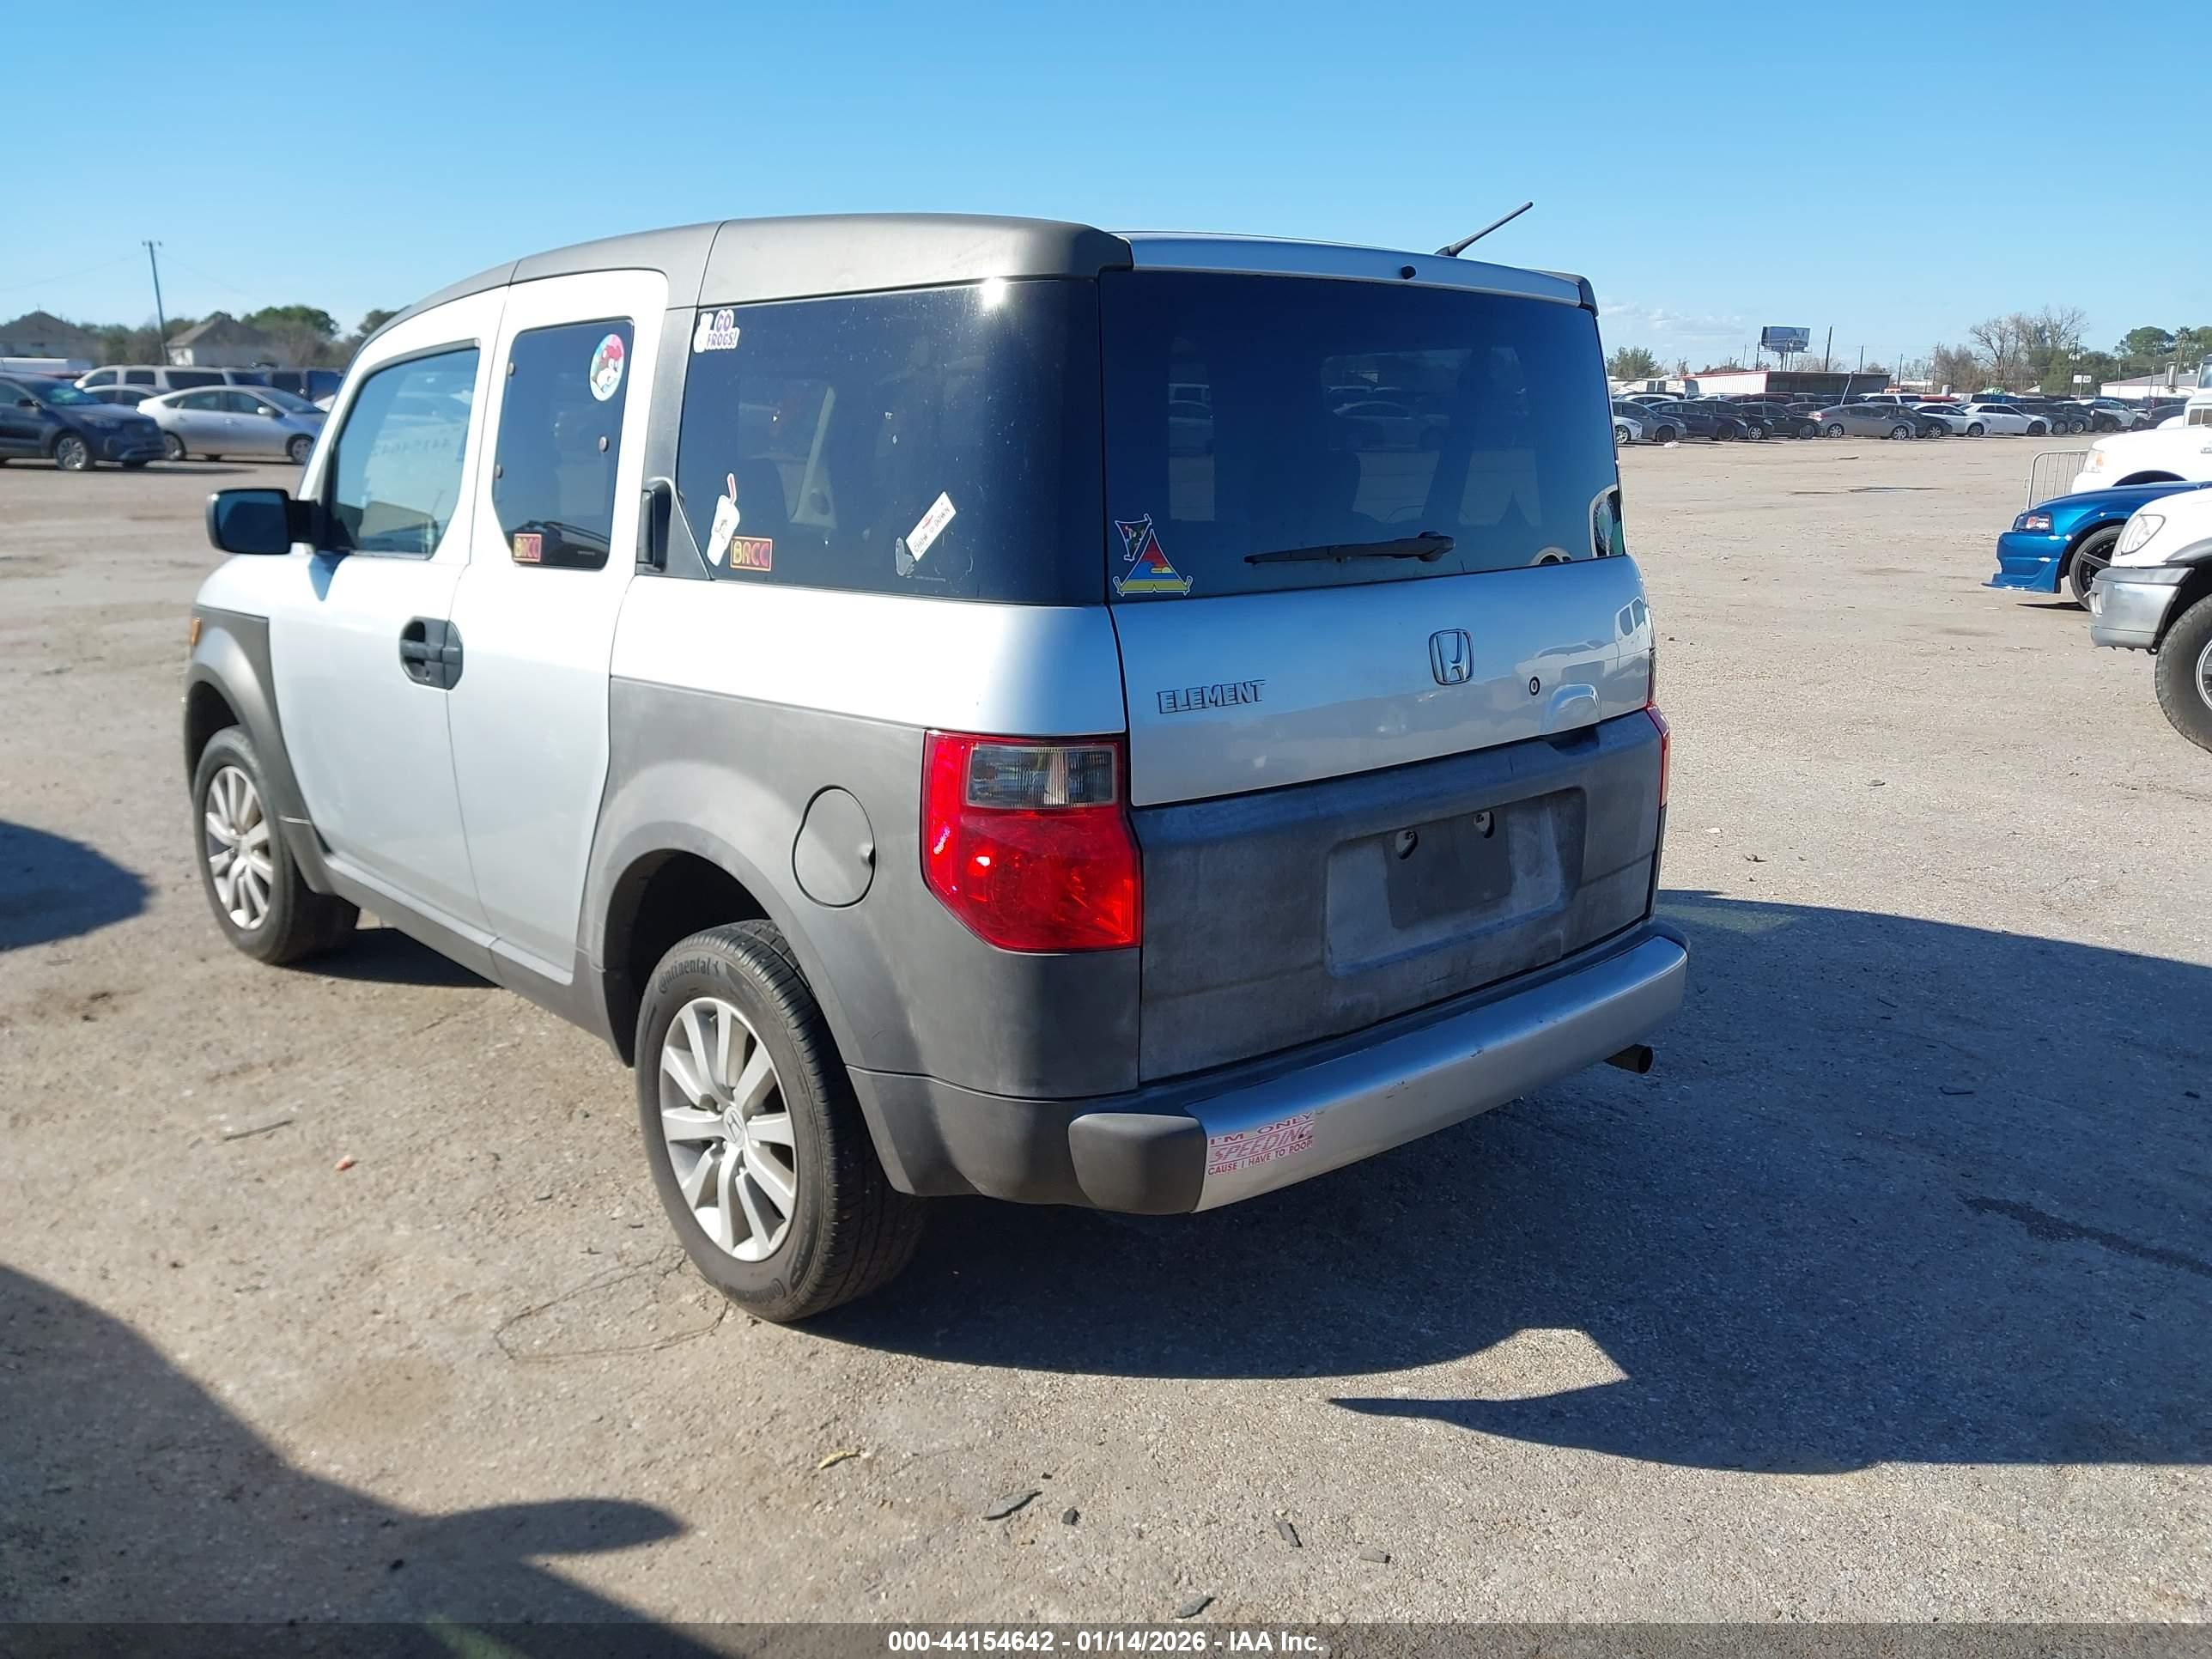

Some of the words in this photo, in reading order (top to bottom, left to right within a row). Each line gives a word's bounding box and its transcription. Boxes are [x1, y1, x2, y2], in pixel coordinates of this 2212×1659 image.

[716, 313, 732, 333] GO
[1157, 679, 1267, 714] ELEMENT
[658, 957, 711, 994] Continental
[1209, 1131, 1245, 1146] I'M
[1256, 1112, 1314, 1134] ONLY
[1209, 1122, 1314, 1163] SPEEDING
[1207, 1162, 1237, 1176] CAUSE
[1248, 1153, 1272, 1167] HAVE
[1275, 1148, 1285, 1158] TO
